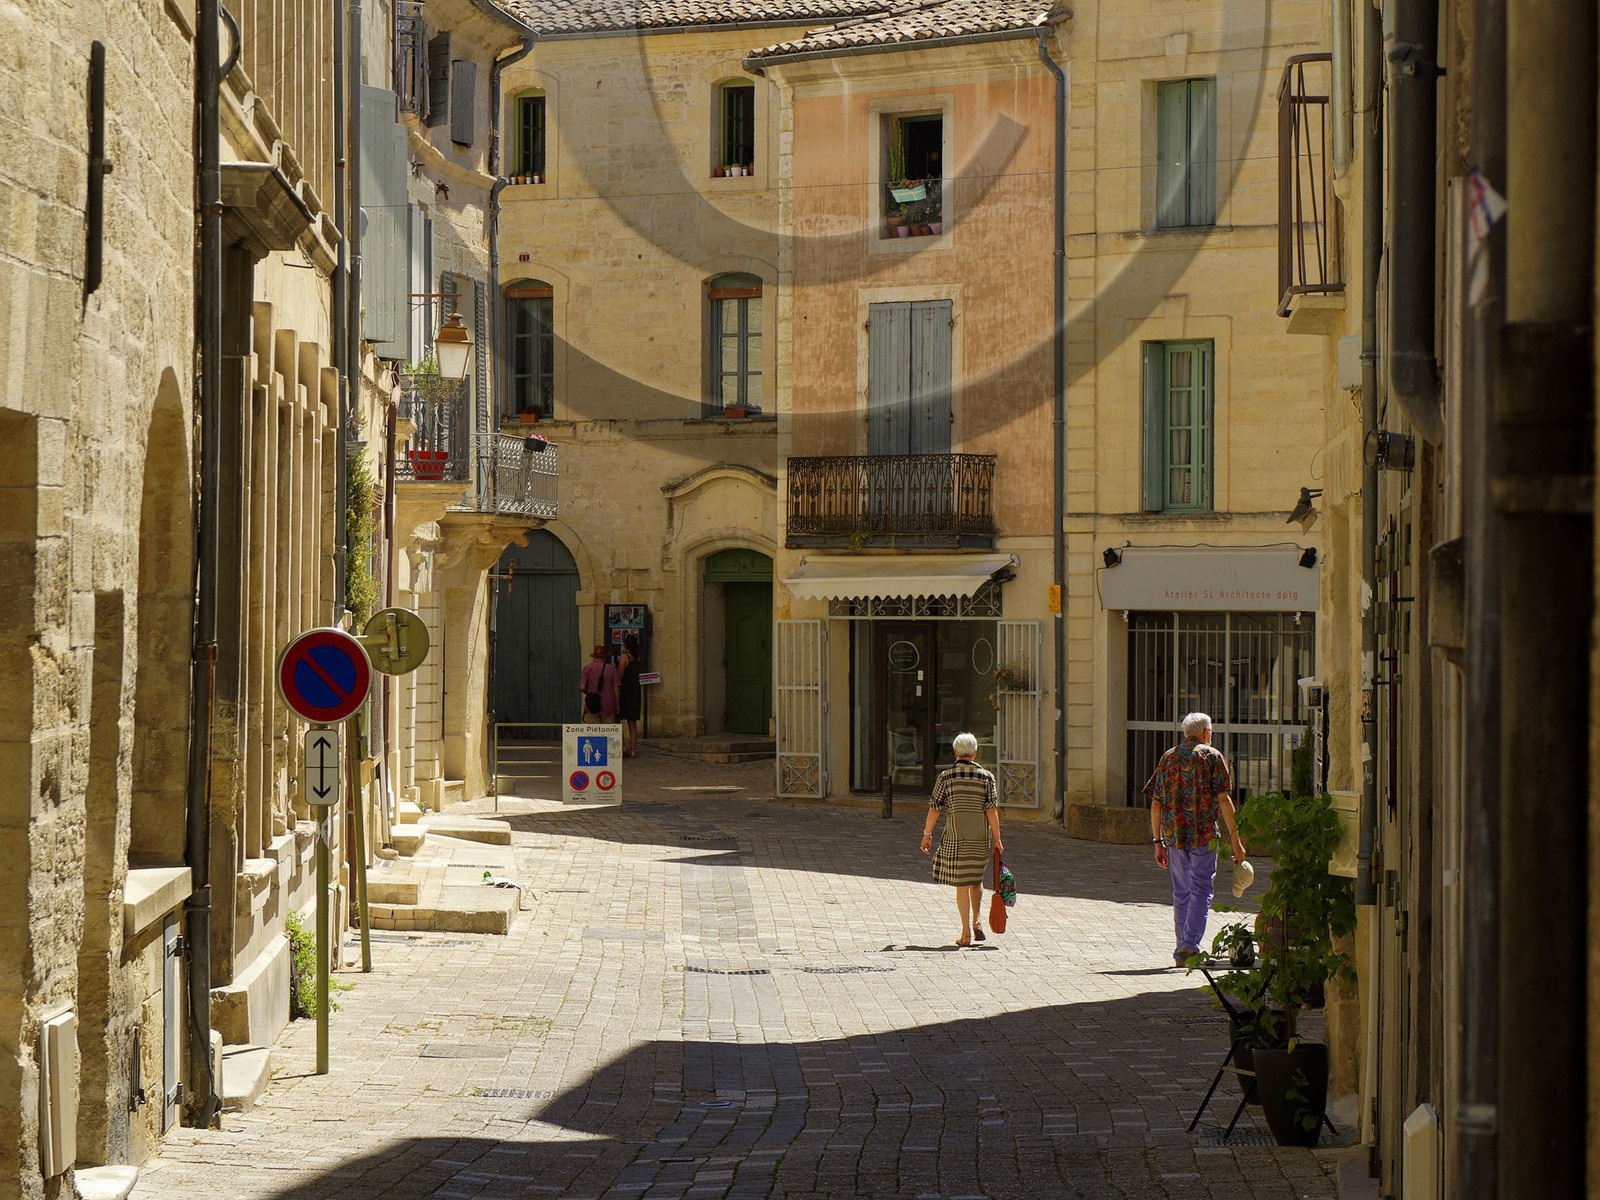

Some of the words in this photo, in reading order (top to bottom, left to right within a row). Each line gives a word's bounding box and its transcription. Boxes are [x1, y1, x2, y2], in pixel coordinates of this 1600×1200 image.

[1164, 590, 1199, 599] Atelier
[1203, 590, 1215, 599] SL
[1219, 590, 1272, 599] Architecte
[1276, 590, 1299, 601] dplg
